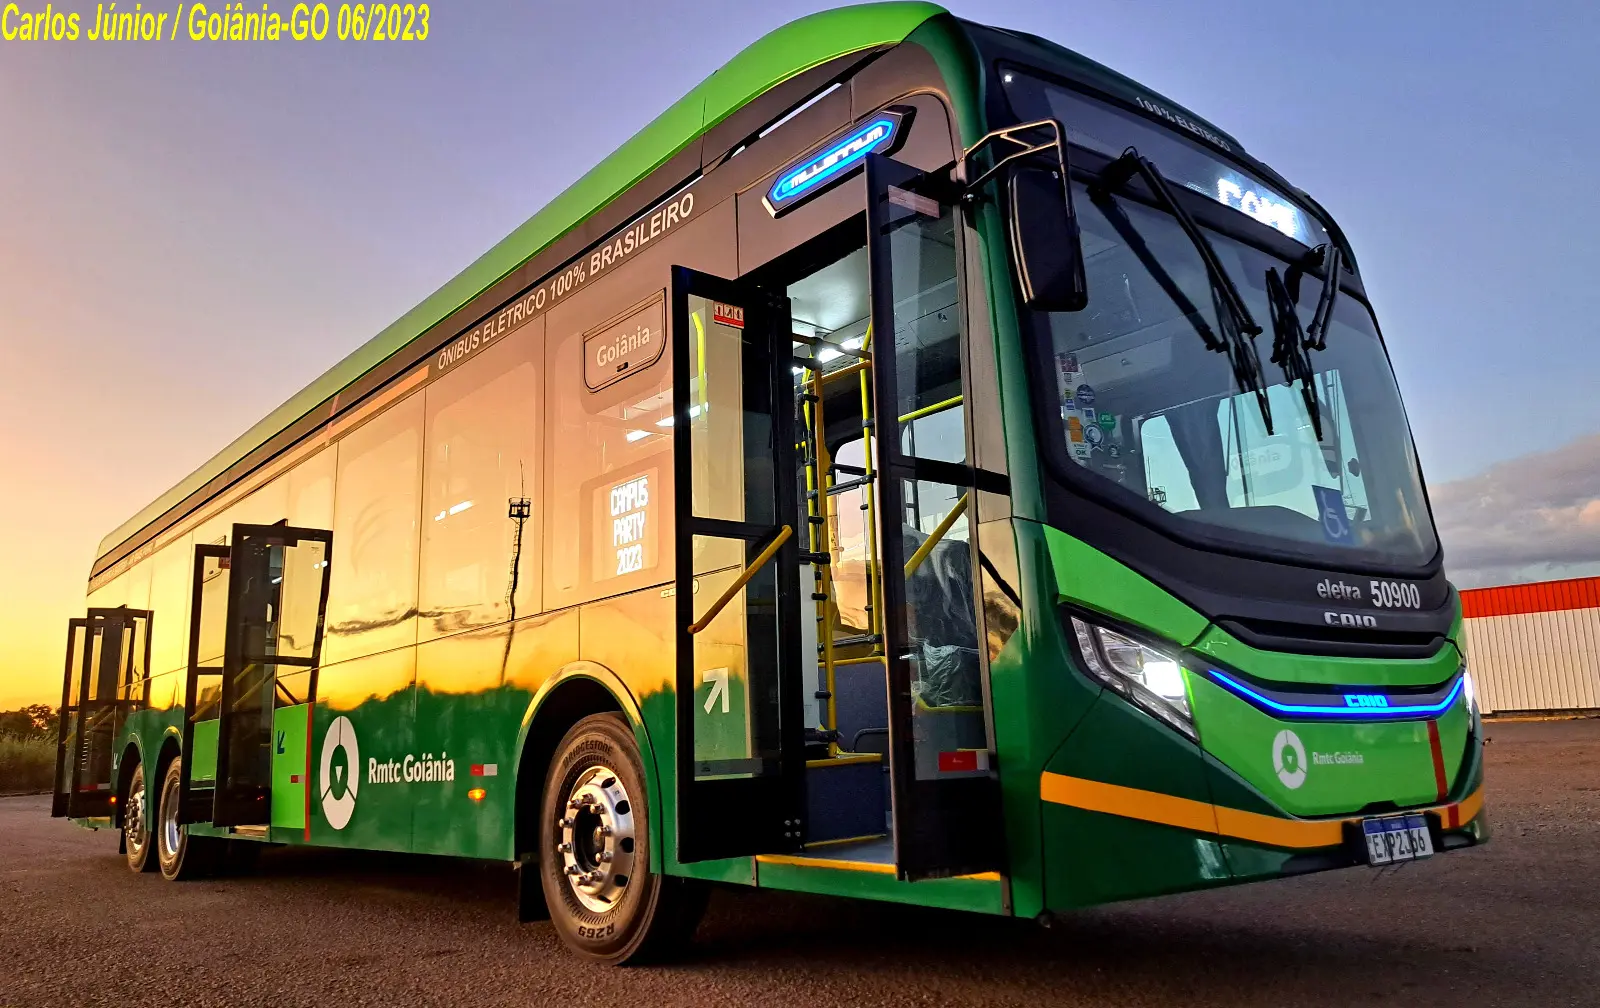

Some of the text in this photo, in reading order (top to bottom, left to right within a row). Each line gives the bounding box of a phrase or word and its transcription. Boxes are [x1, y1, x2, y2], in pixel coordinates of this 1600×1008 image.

[1136, 96, 1175, 122] 100%
[438, 192, 695, 371] ÔNIBUS ELÉTRICO 100% BRASILEIRO
[596, 325, 651, 367] Goiânia
[610, 477, 649, 517] CAMPUS
[613, 510, 645, 547] PARTY
[616, 543, 643, 576] 2023
[1317, 578, 1421, 610] eletra 50900
[1323, 611, 1377, 628] CAIO
[1343, 694, 1389, 708] CAIO
[368, 751, 455, 784] Rmtc Goiânia
[562, 739, 614, 770] BRIDGESTONE
[1312, 751, 1364, 765] Rmtc Goiânia
[577, 922, 615, 939] R269
